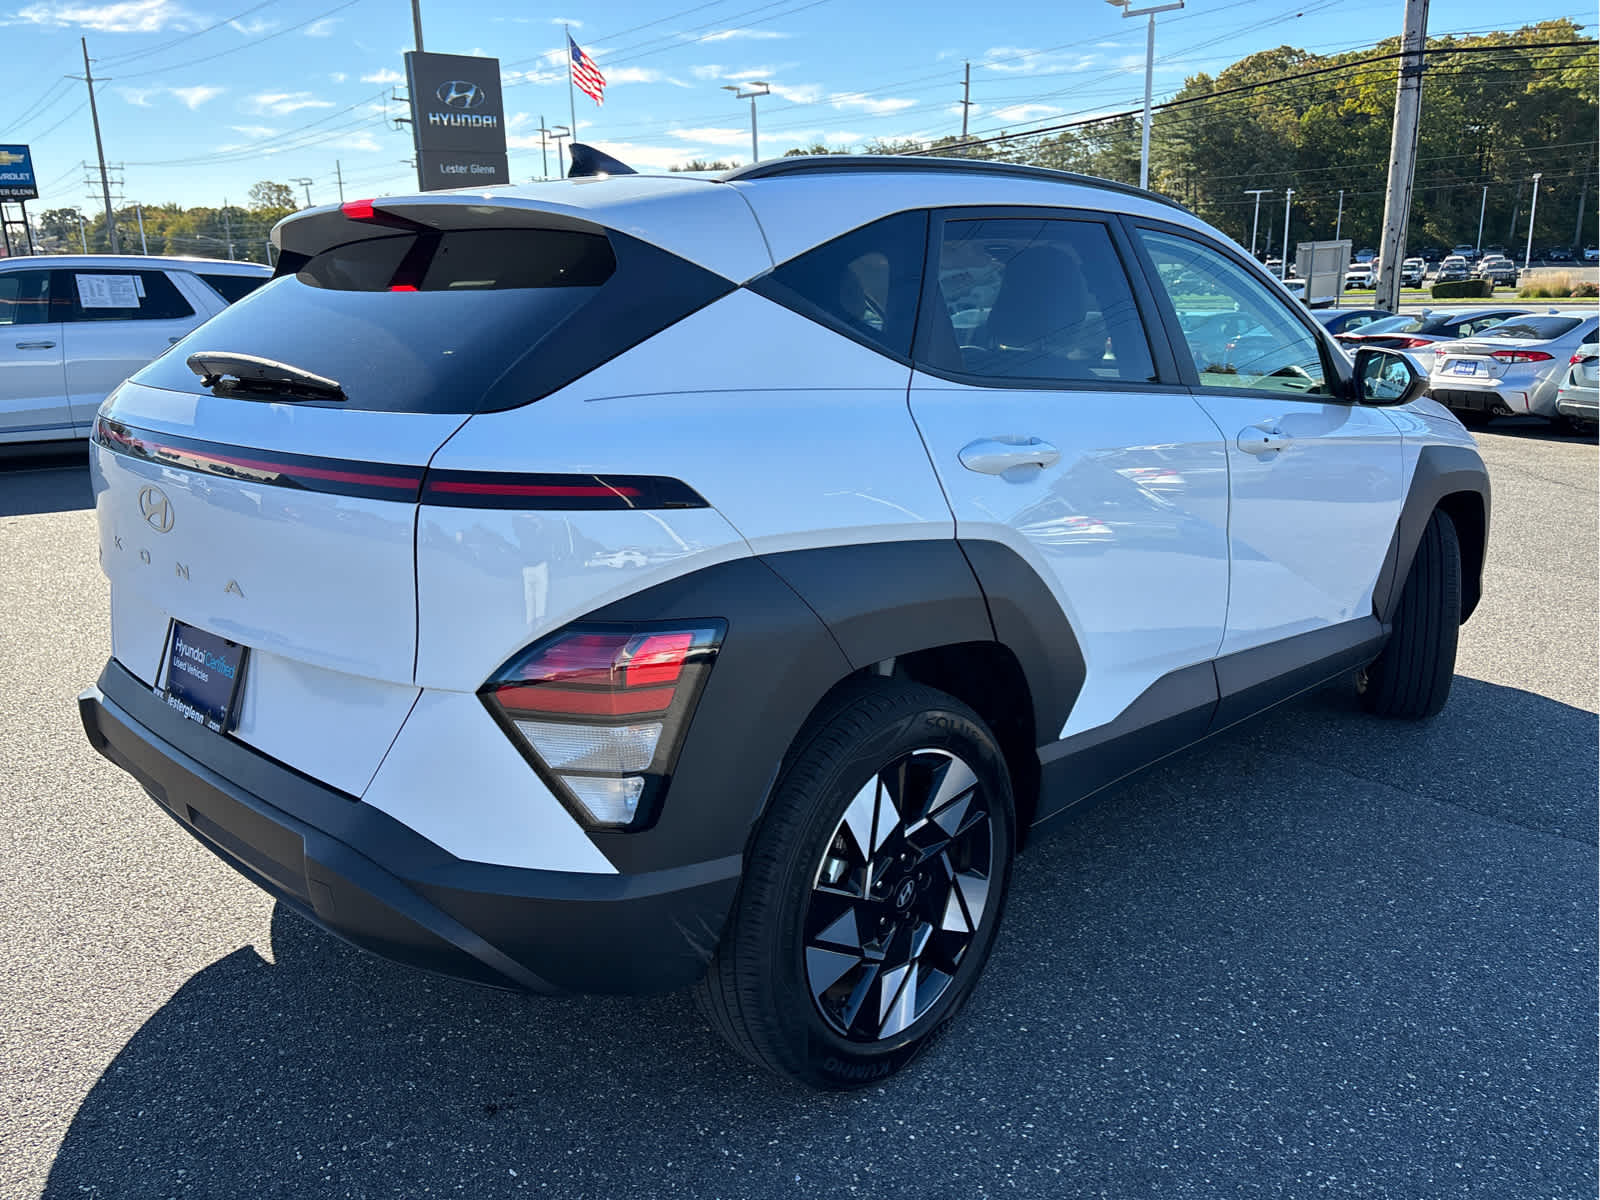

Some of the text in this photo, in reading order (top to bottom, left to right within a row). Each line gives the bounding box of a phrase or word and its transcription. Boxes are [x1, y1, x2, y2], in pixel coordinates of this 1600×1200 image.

[428, 112, 498, 128] HYUNDAI
[440, 164, 496, 175] Lester Glenn
[11, 188, 35, 196] GLENN
[114, 535, 244, 598] KONA
[174, 656, 208, 682] Used Vehicles
[175, 638, 235, 679] Hyundai Certified
[926, 716, 981, 740] SOLUS
